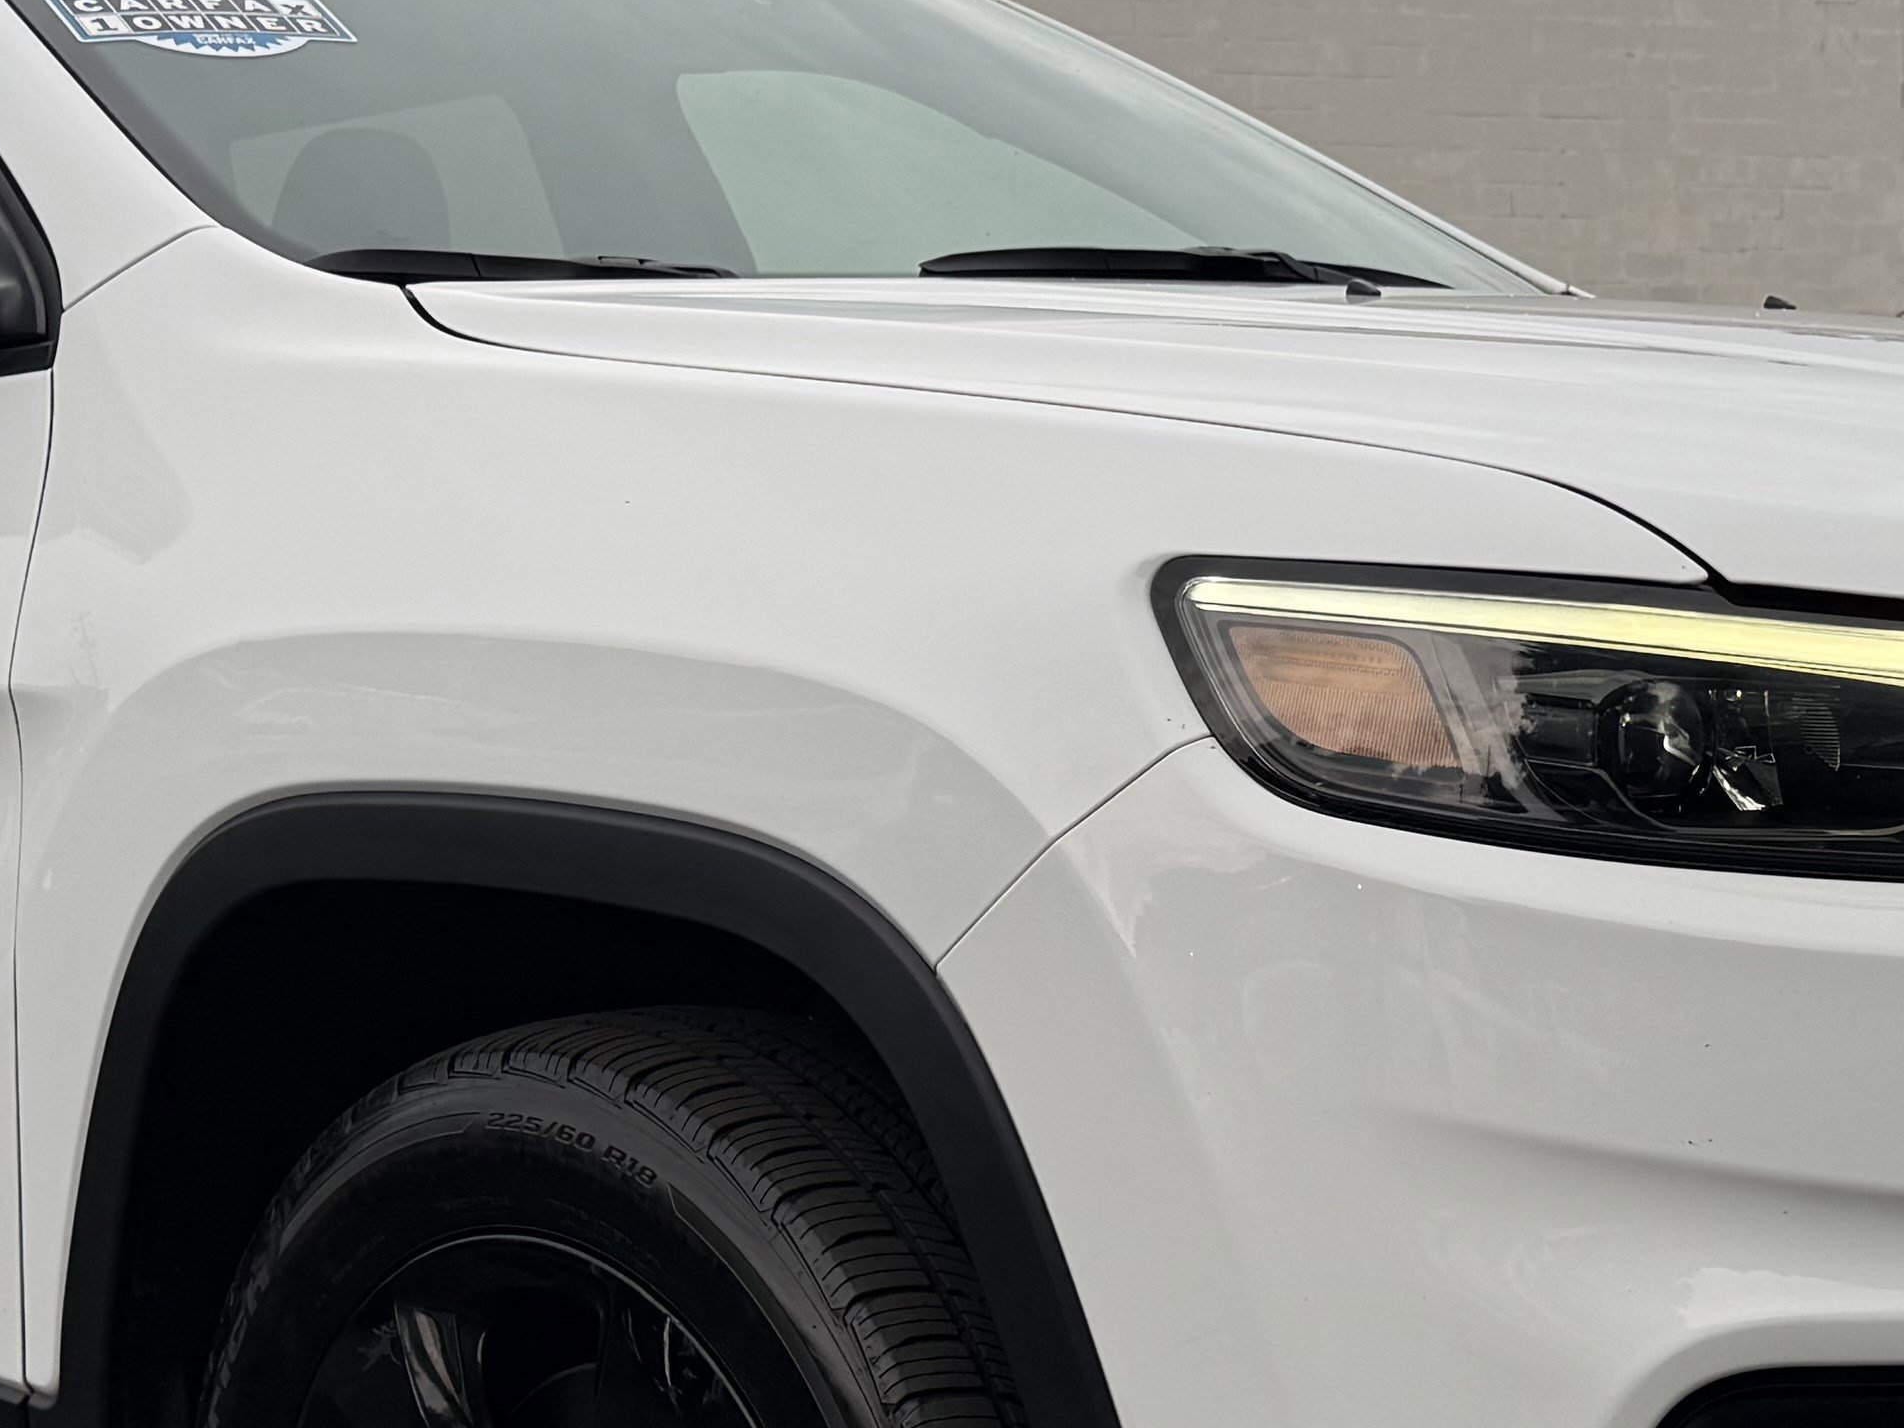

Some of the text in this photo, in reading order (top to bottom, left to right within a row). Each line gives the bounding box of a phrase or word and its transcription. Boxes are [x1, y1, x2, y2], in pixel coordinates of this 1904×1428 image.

[85, 14, 330, 34] 1 OWNER
[485, 1111, 659, 1190] 225/60 R18
